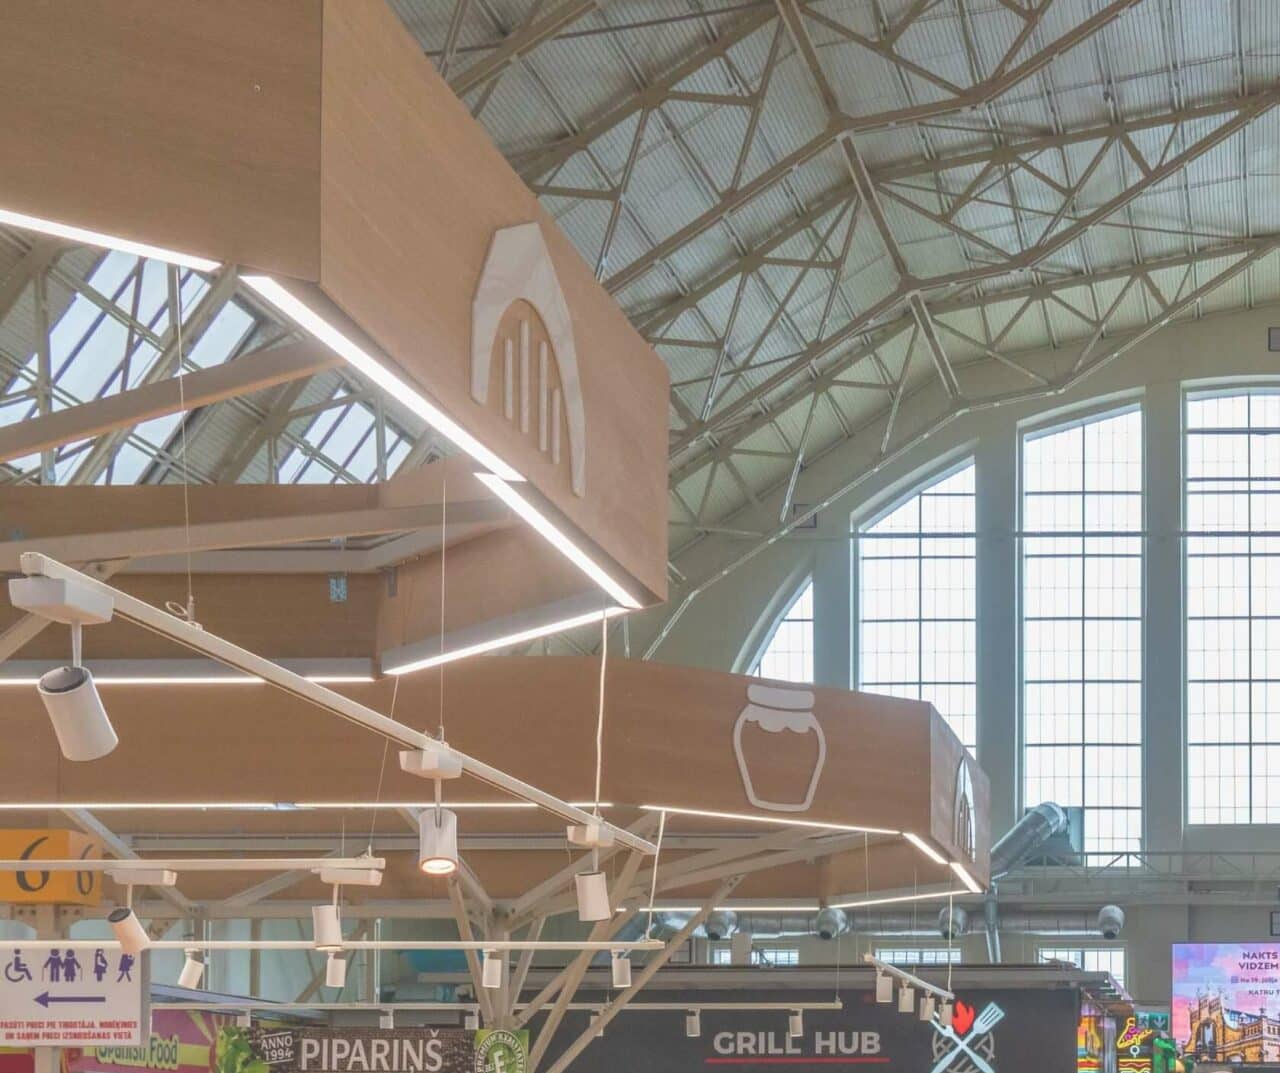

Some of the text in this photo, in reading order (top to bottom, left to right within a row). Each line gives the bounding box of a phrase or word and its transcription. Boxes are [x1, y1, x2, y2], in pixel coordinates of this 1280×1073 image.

[16, 836, 50, 892] 6
[77, 843, 95, 895] 6
[1243, 952, 1278, 960] NAKTS
[150, 1036, 179, 1065] Food
[260, 1036, 294, 1050] ANNO
[713, 1031, 881, 1055] GRILL HUB
[264, 1049, 294, 1062] 1994
